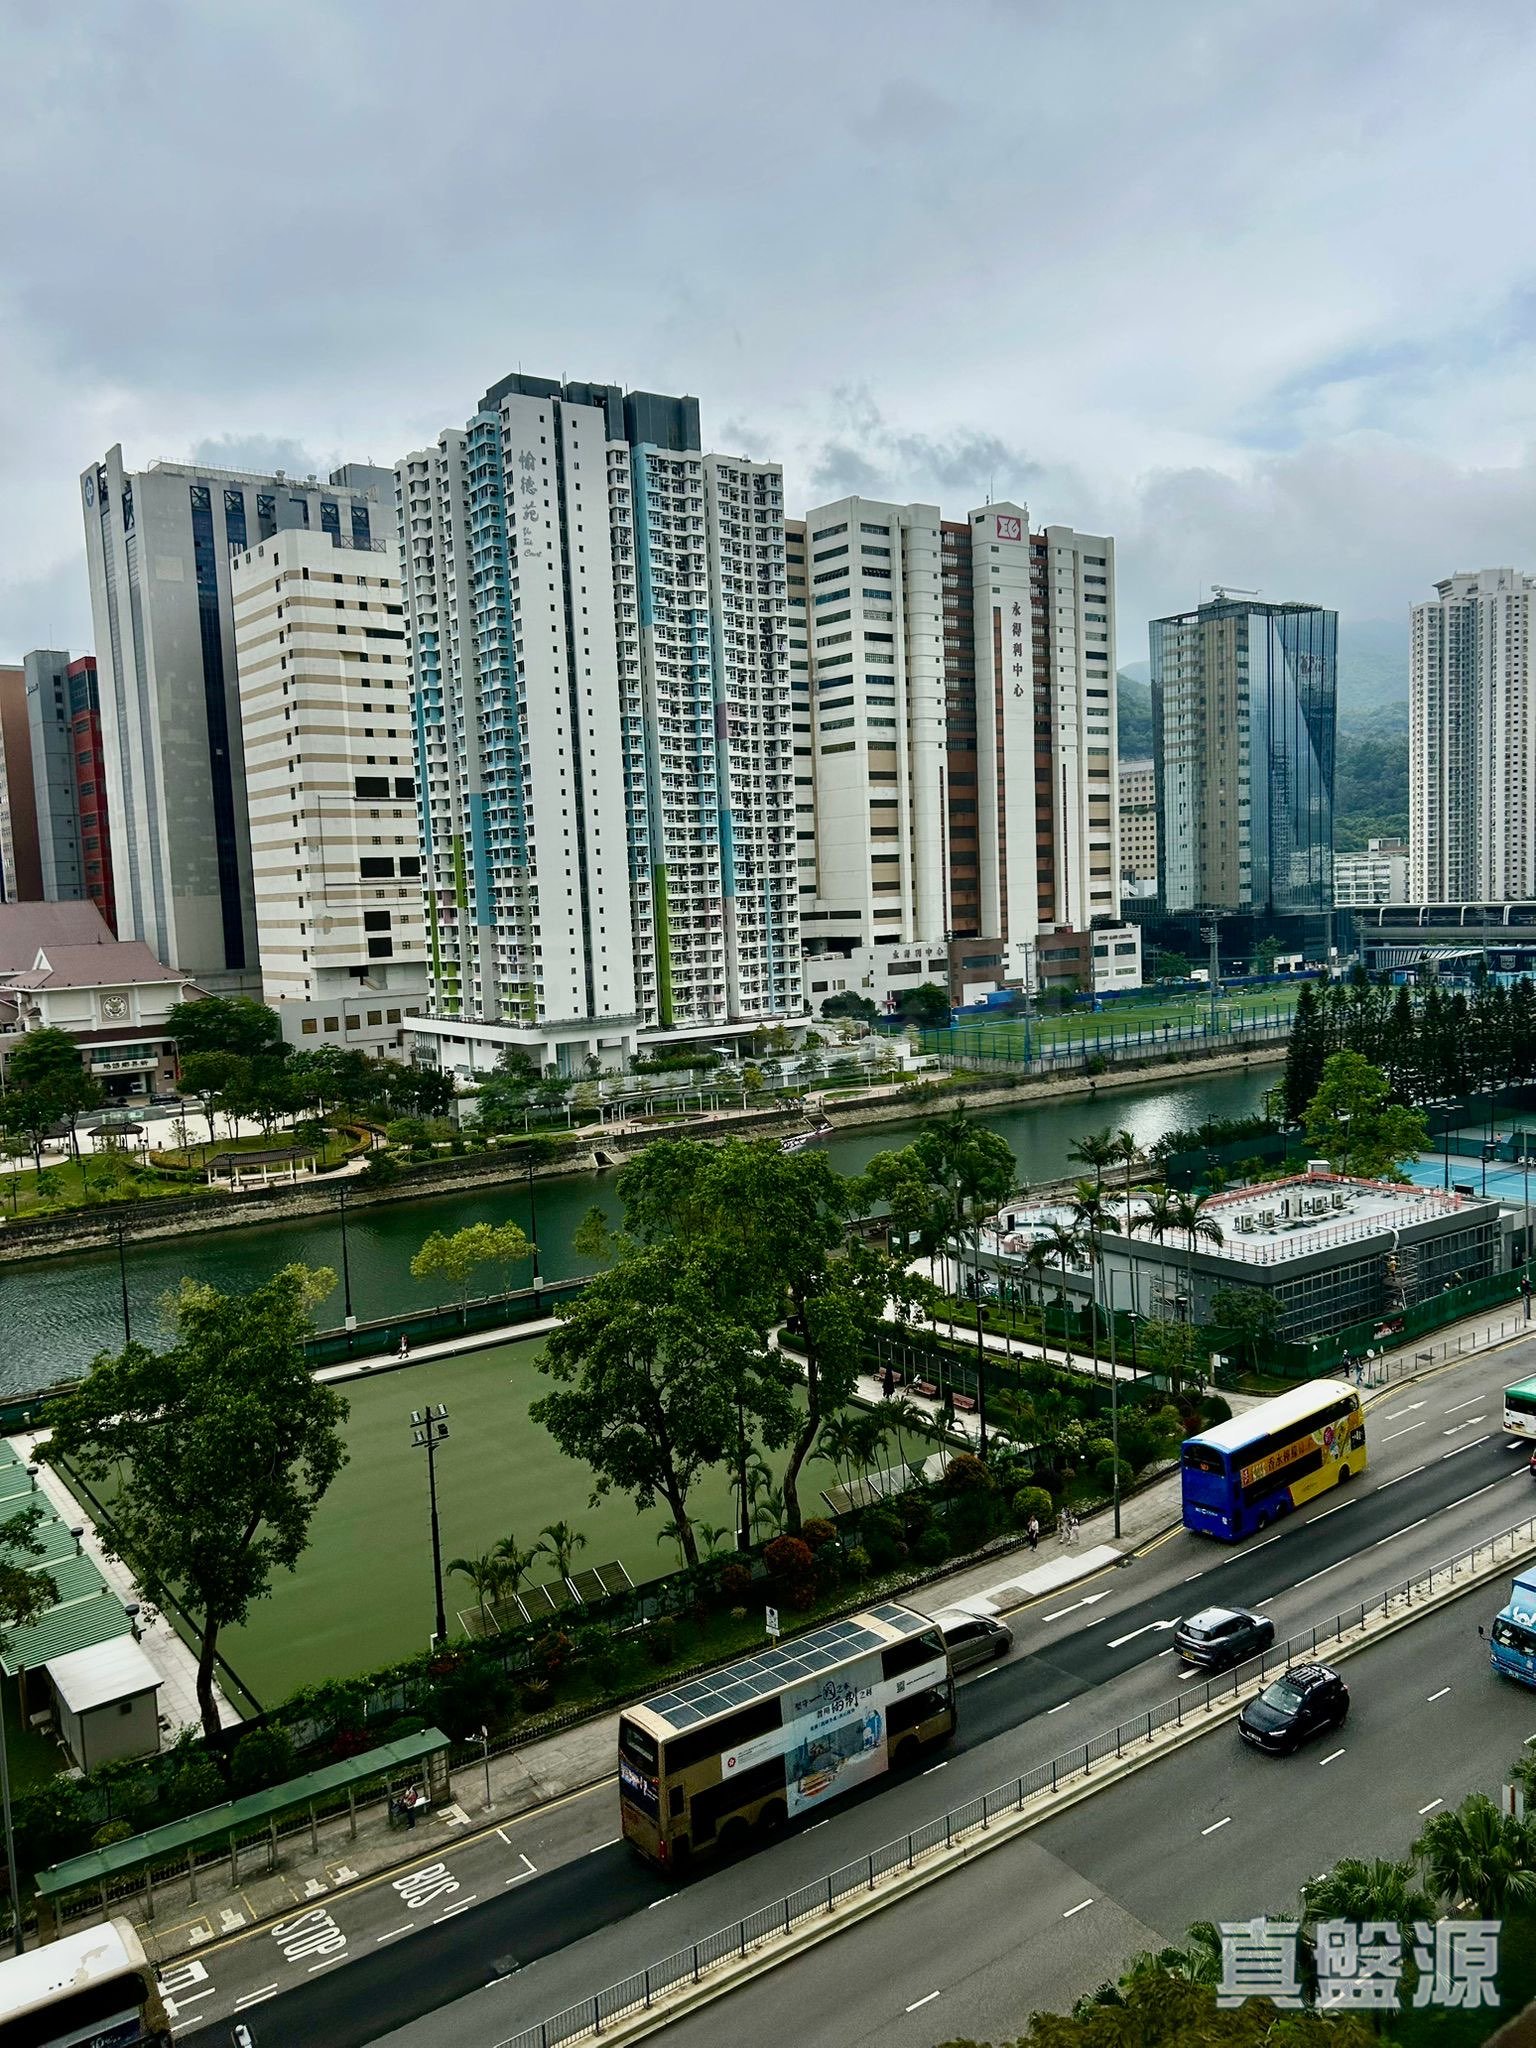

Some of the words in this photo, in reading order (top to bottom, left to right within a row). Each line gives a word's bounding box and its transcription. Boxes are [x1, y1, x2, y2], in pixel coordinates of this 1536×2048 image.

[1011, 601, 1024, 698] 永得利中心
[391, 1862, 461, 1909] BUS
[271, 1908, 348, 1963] STOP
